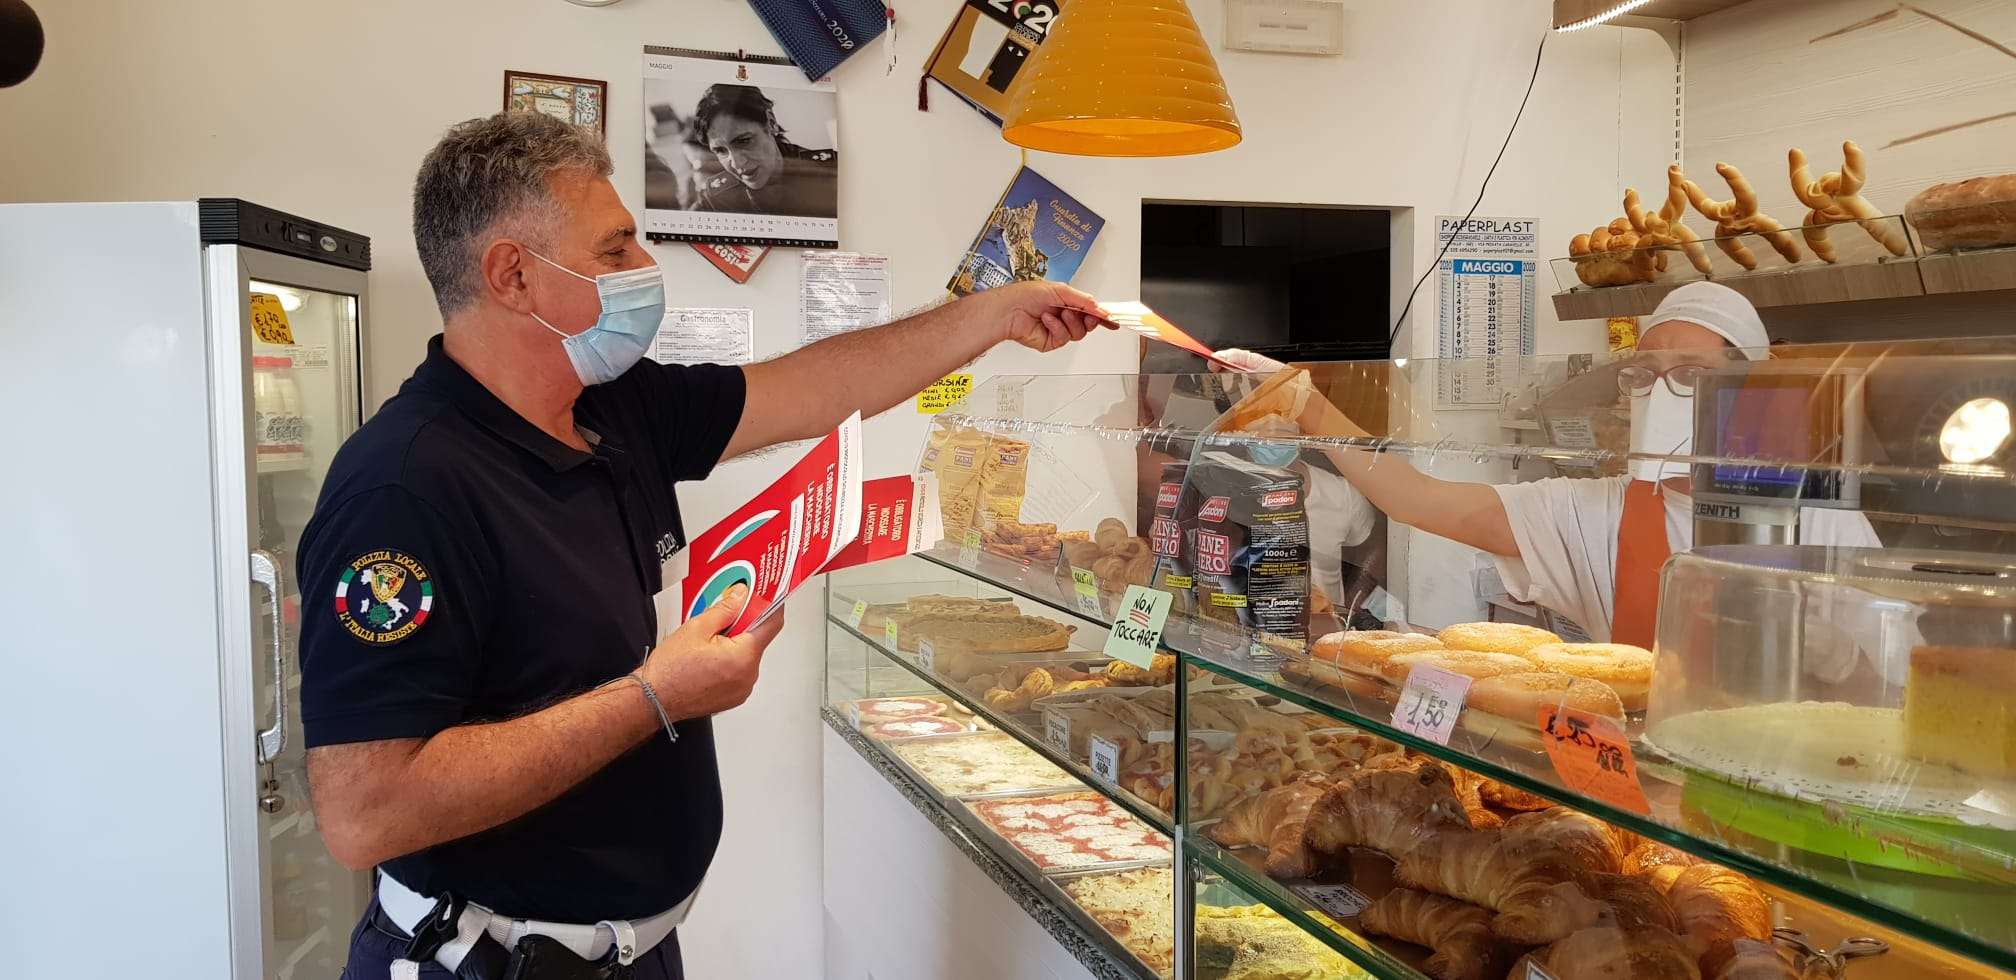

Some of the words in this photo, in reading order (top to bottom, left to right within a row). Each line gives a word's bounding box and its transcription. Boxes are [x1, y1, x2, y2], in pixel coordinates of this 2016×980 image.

[826, 19, 855, 50] 2020
[649, 62, 673, 70] MAGGIO
[1441, 219, 1533, 233] PAPERPLAST
[1461, 262, 1514, 273] MAGGIO
[680, 315, 726, 323] Gastronomia
[807, 480, 816, 495] LA
[812, 482, 825, 537] INDOSSARE
[821, 471, 834, 540] OBBLIGATORIO
[1695, 503, 1740, 518] ZENITH
[801, 494, 815, 556] MASCHERINA
[862, 509, 877, 545] MASCHERINA
[878, 507, 891, 537] INDOSSARE
[891, 503, 904, 541] OBBLIGATORIO
[1200, 534, 1224, 555] ANE
[352, 551, 391, 572] POLIZIA
[394, 553, 428, 581] LOCALE
[1200, 556, 1226, 573] ERO
[1133, 593, 1157, 615] NON
[1269, 598, 1300, 608] Spadoni
[339, 611, 375, 641] L'ITALIA
[376, 620, 418, 643] RESISTE
[1113, 620, 1158, 649] TOCCARE
